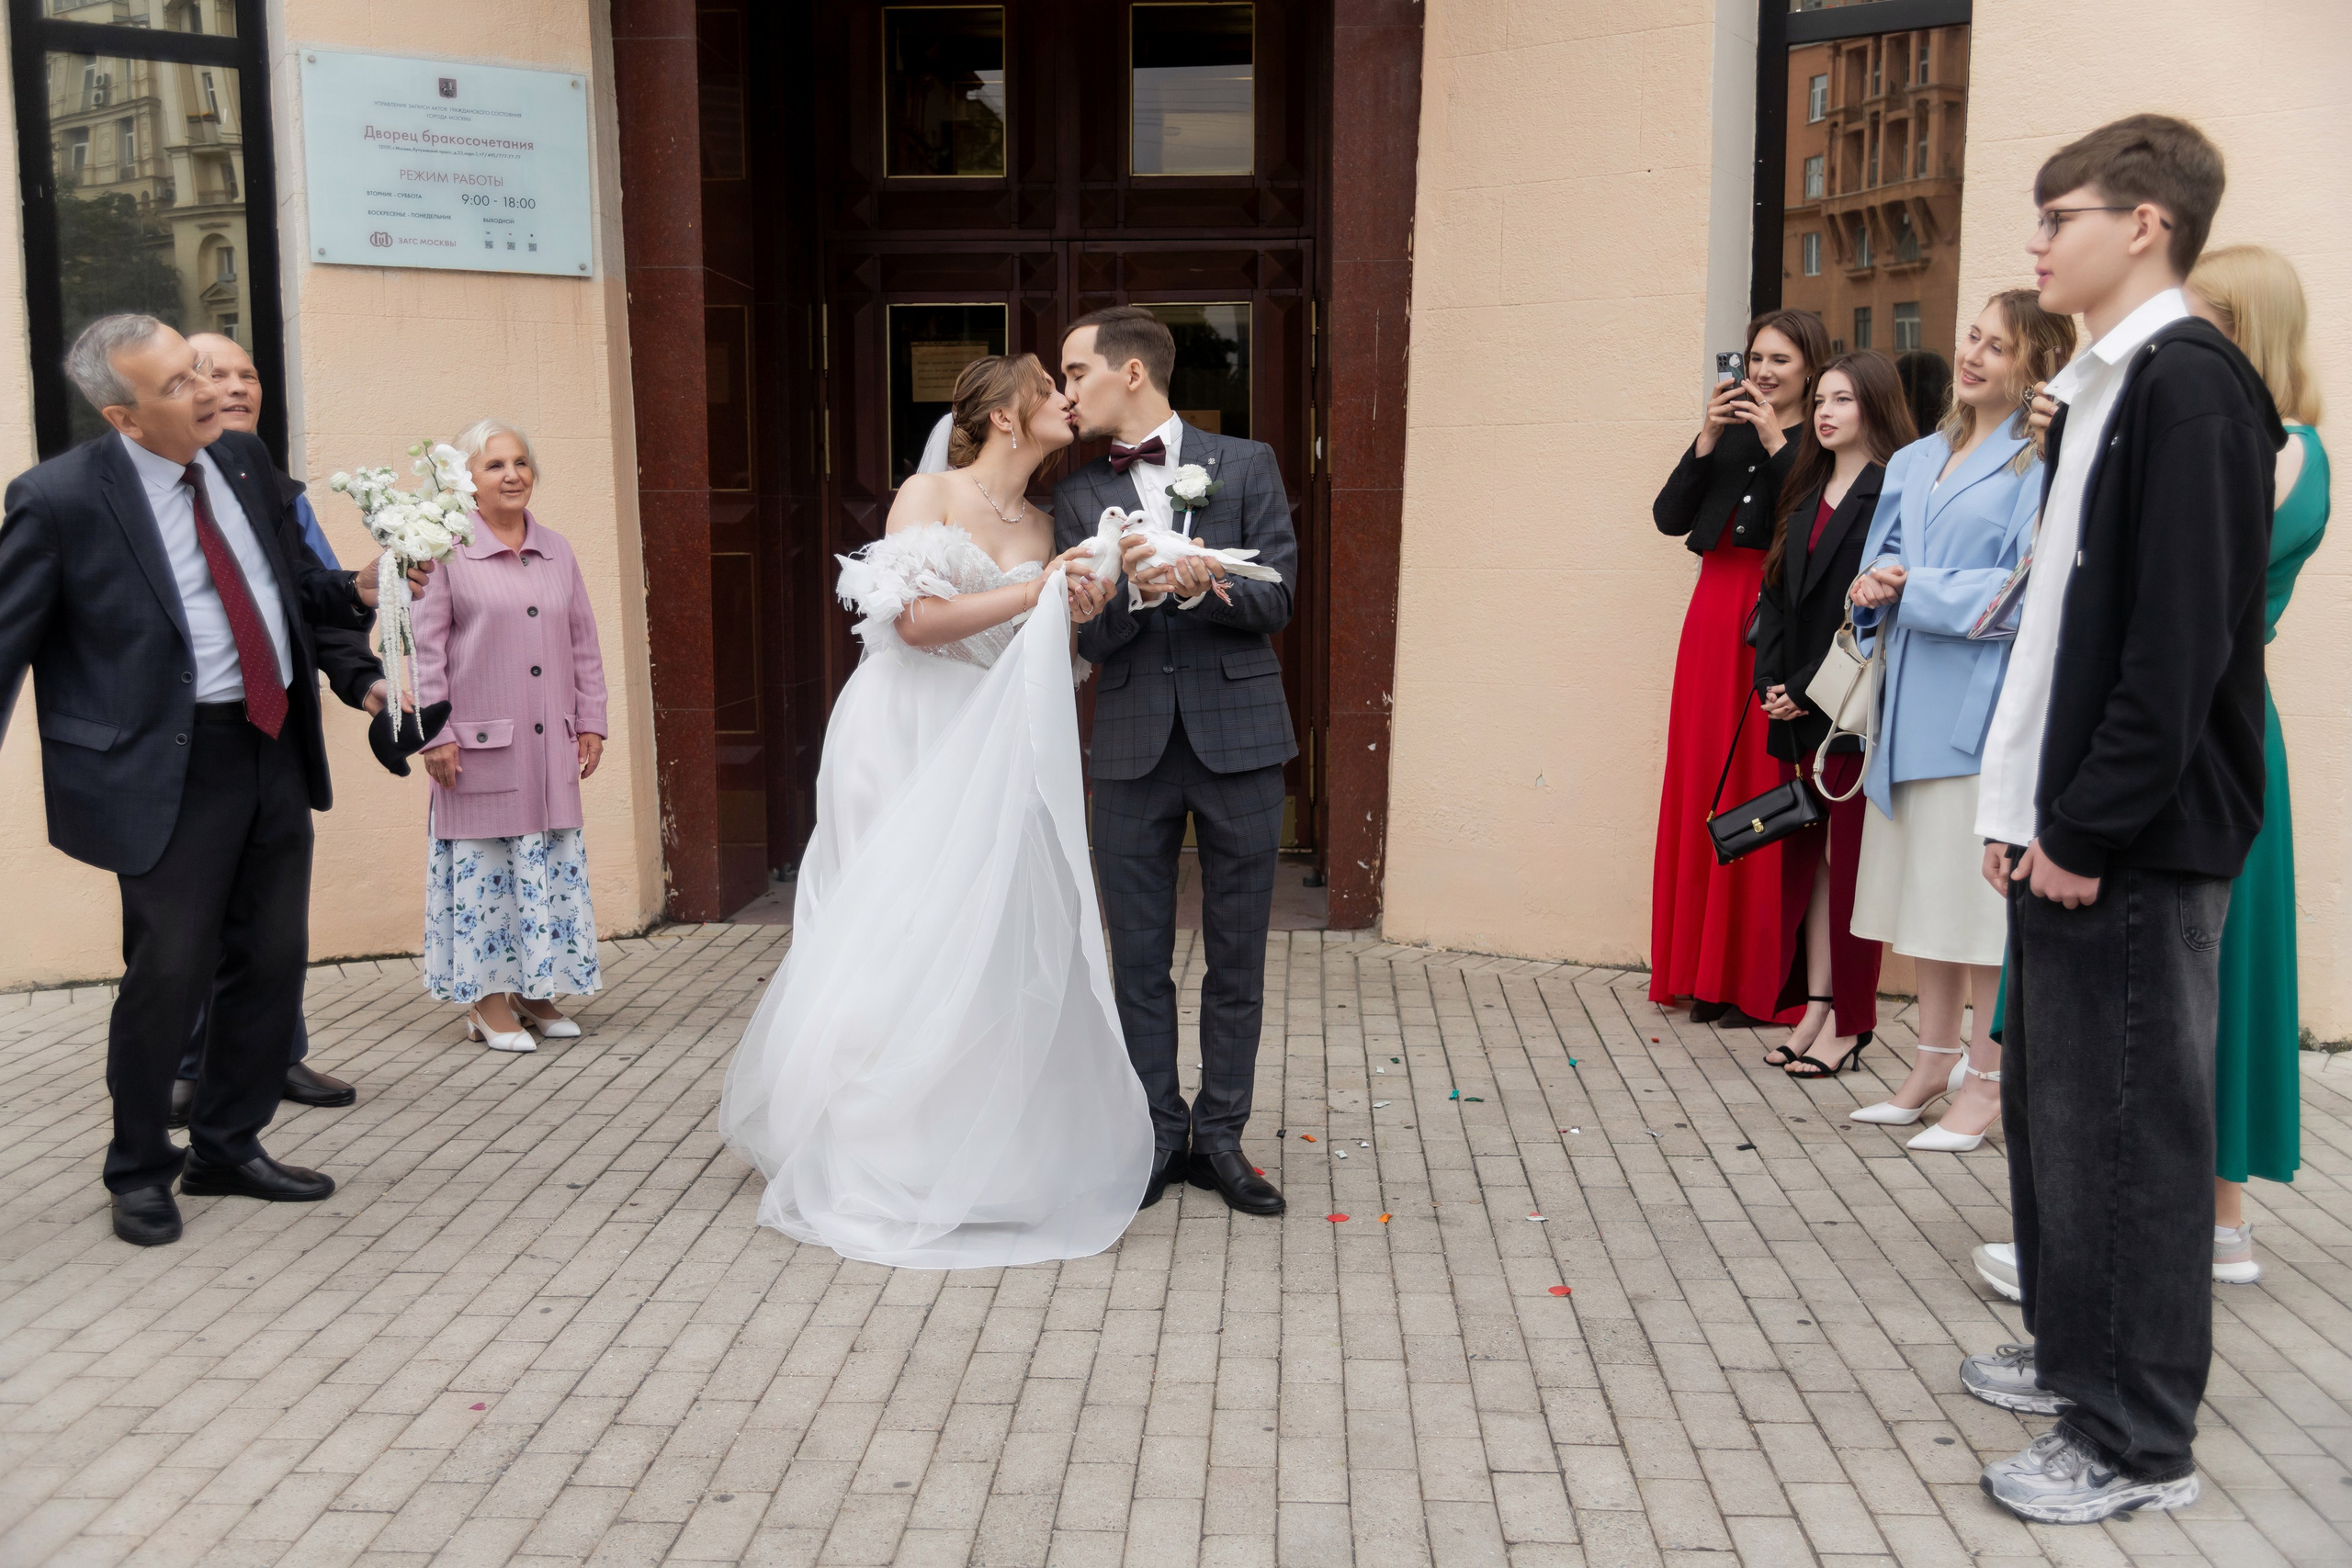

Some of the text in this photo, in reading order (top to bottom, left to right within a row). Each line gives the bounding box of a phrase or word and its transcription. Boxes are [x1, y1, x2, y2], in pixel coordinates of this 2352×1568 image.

[450, 107, 490, 116] ГРАЖДАНСКОГО
[364, 125, 534, 151] Дворец бракосочетания
[400, 169, 503, 187] РЕЖИМ РАБОТЫ
[461, 194, 490, 207] 9:00
[503, 197, 537, 209] 18:00
[368, 209, 406, 218] ВОСКРЕСЕНЬЕ
[411, 212, 452, 220] ПОНЕДЕЛЬНИК
[482, 217, 514, 225] ВЫХОДНОЙ
[398, 237, 457, 247] ЗАГС МОСКВЫ
